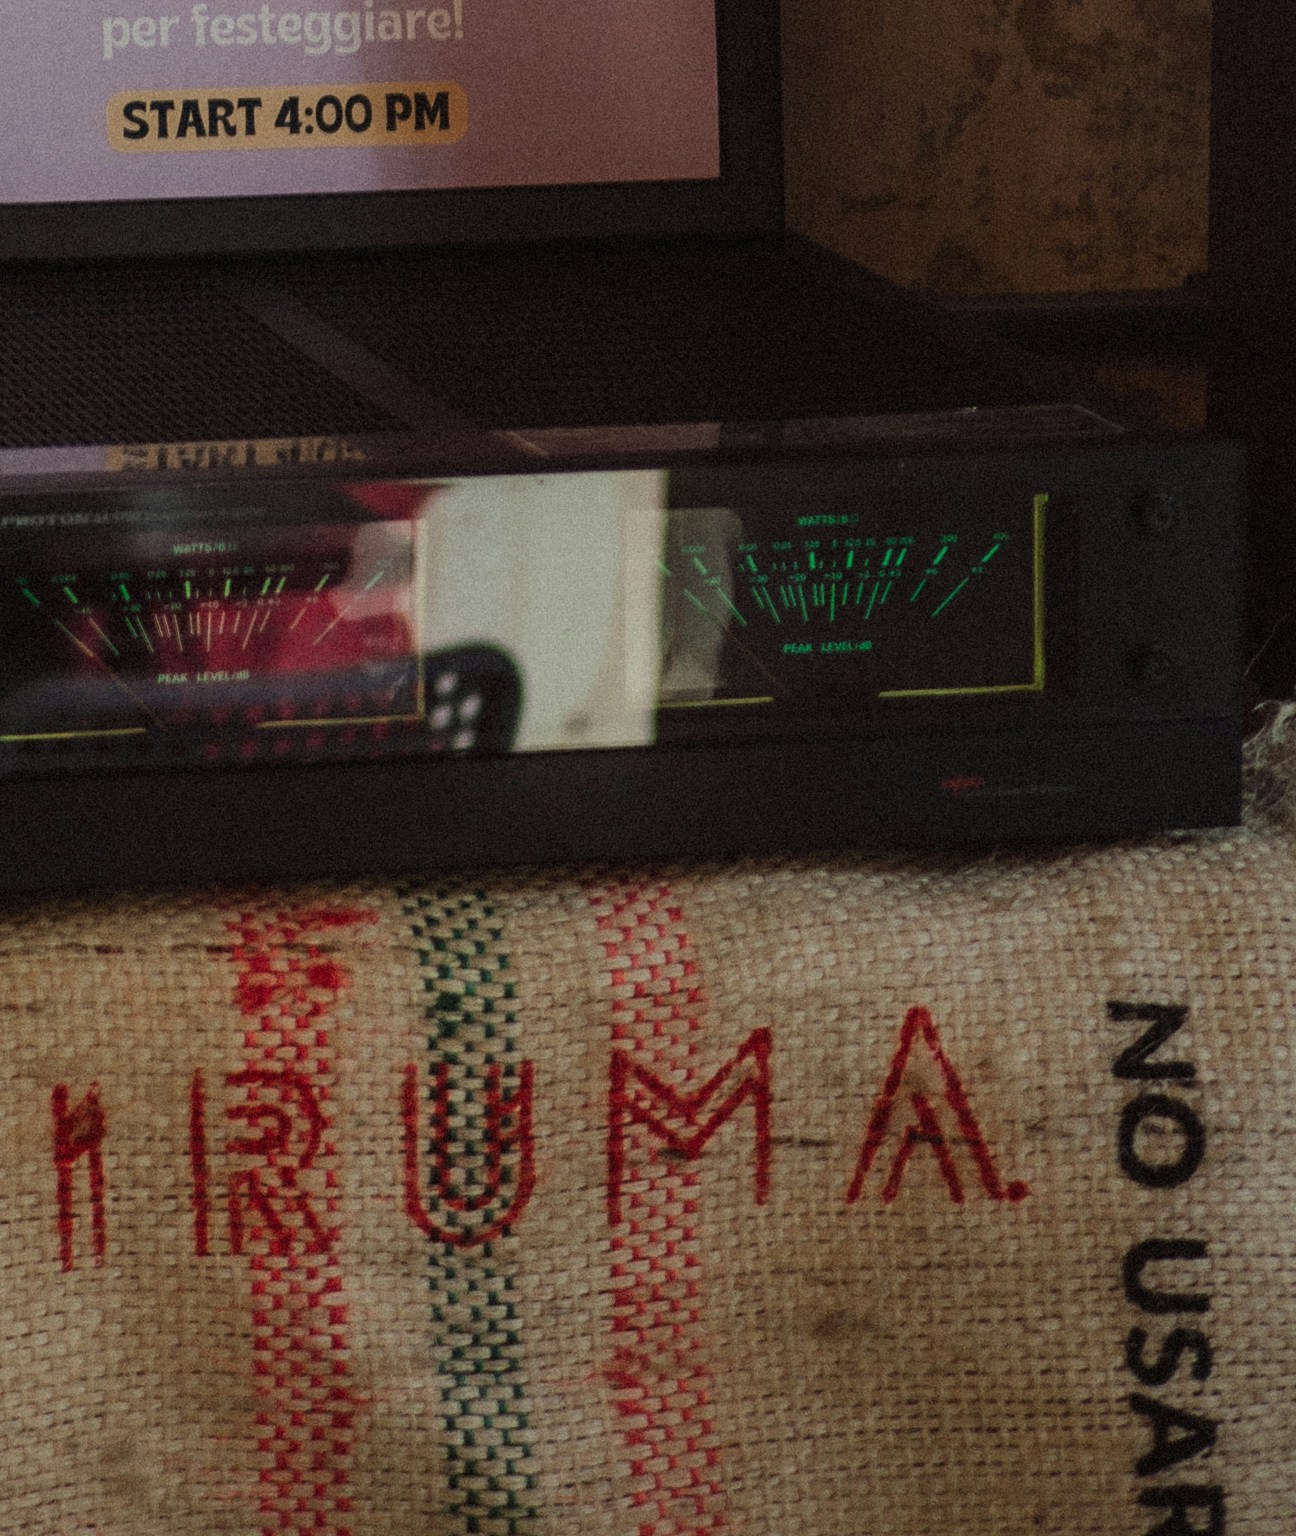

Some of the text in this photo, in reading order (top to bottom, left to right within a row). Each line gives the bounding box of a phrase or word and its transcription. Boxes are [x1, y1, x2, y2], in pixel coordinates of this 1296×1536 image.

[102, 9, 179, 60] per
[122, 90, 451, 140] START 4:00 PM
[1105, 1000, 1207, 1190] NO
